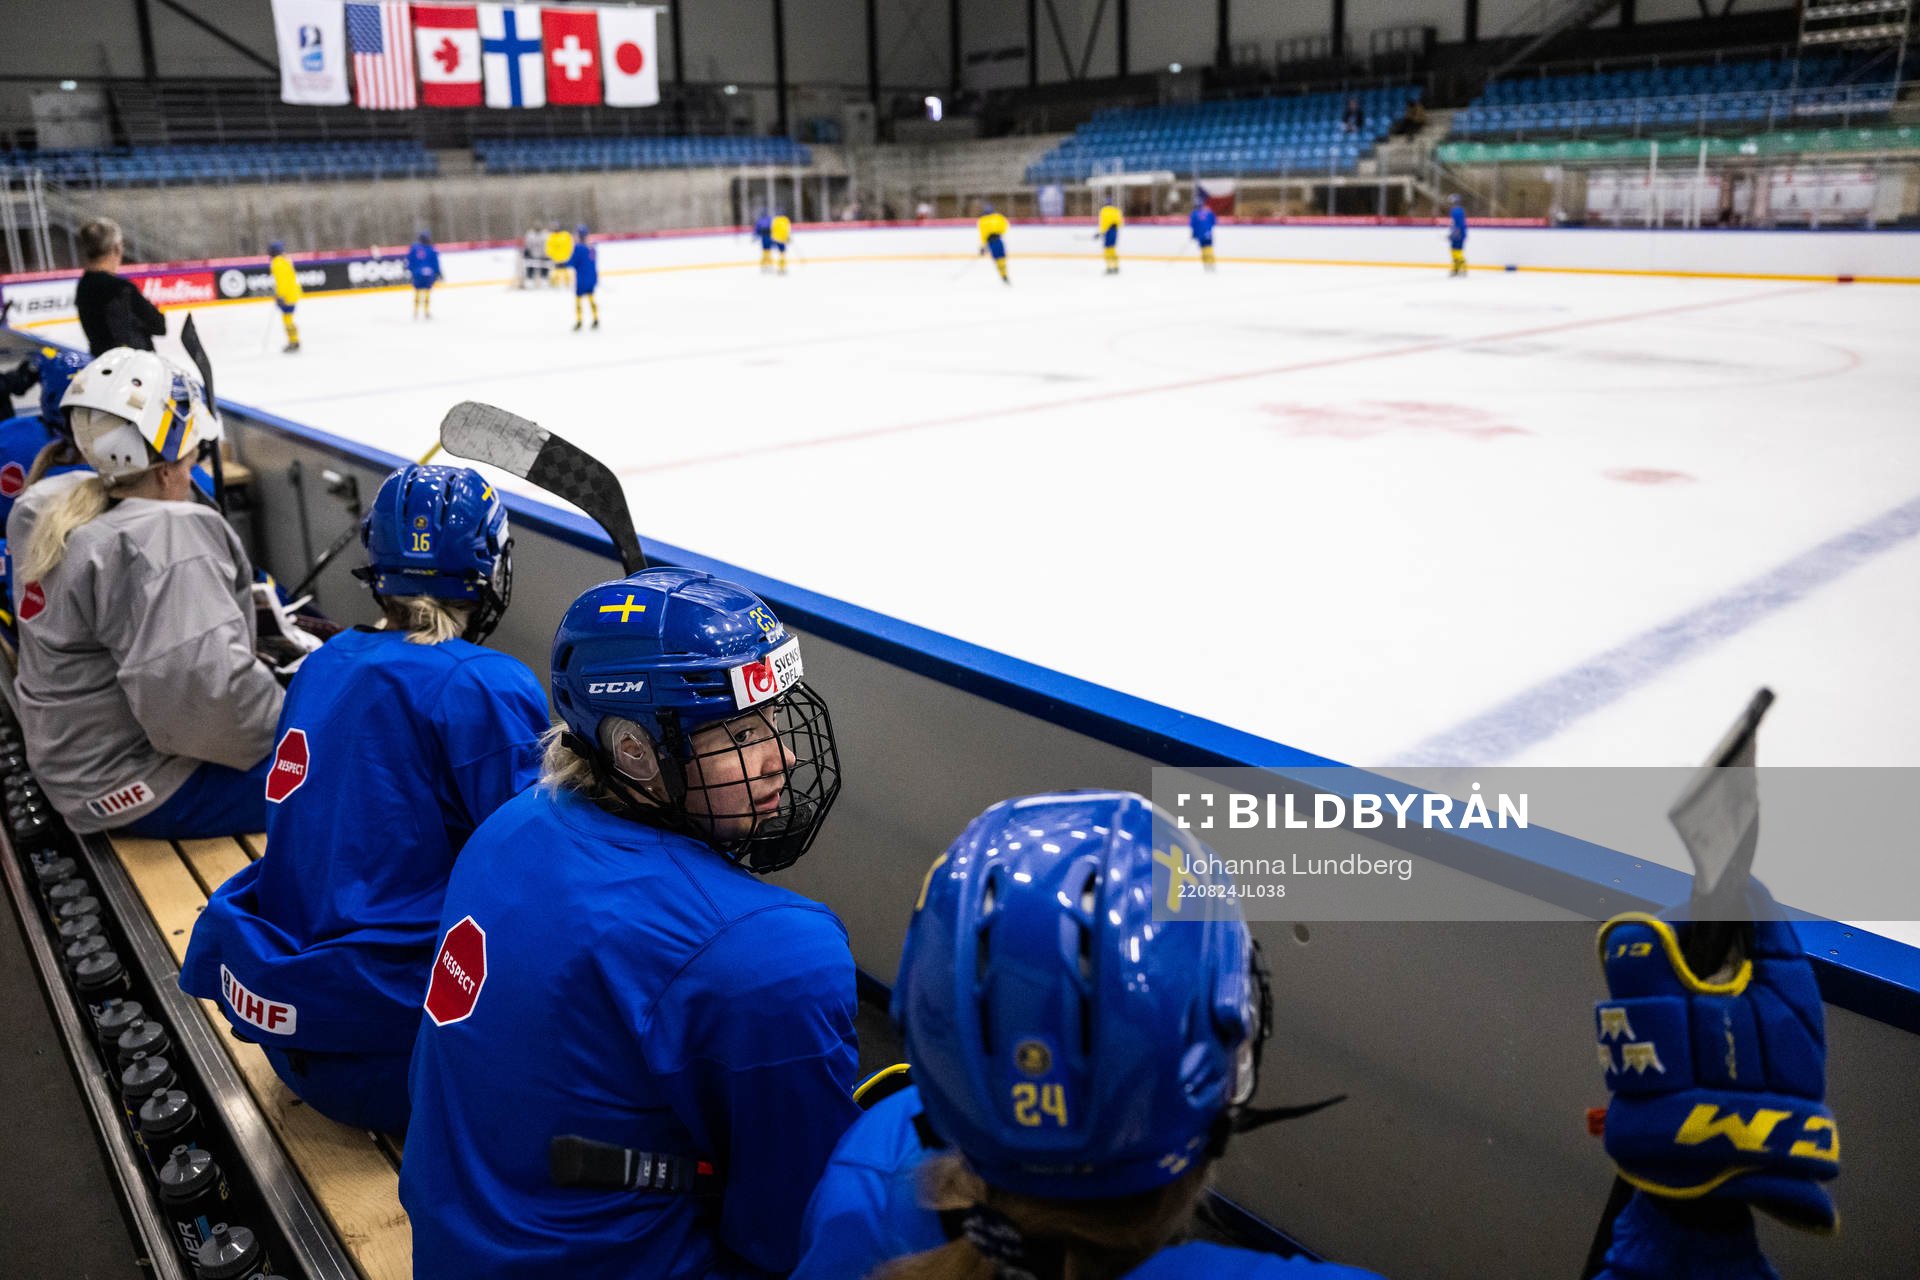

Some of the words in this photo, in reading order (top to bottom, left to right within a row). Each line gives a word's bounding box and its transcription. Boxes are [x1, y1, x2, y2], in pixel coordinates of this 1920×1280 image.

[412, 532, 431, 552] 16
[749, 606, 776, 633] 25
[588, 681, 644, 694] CCM
[277, 759, 304, 776] RESPECT
[100, 785, 145, 814] IIHF
[442, 950, 475, 995] RESPECT
[232, 980, 288, 1029] IIHF
[1012, 1082, 1068, 1127] 24
